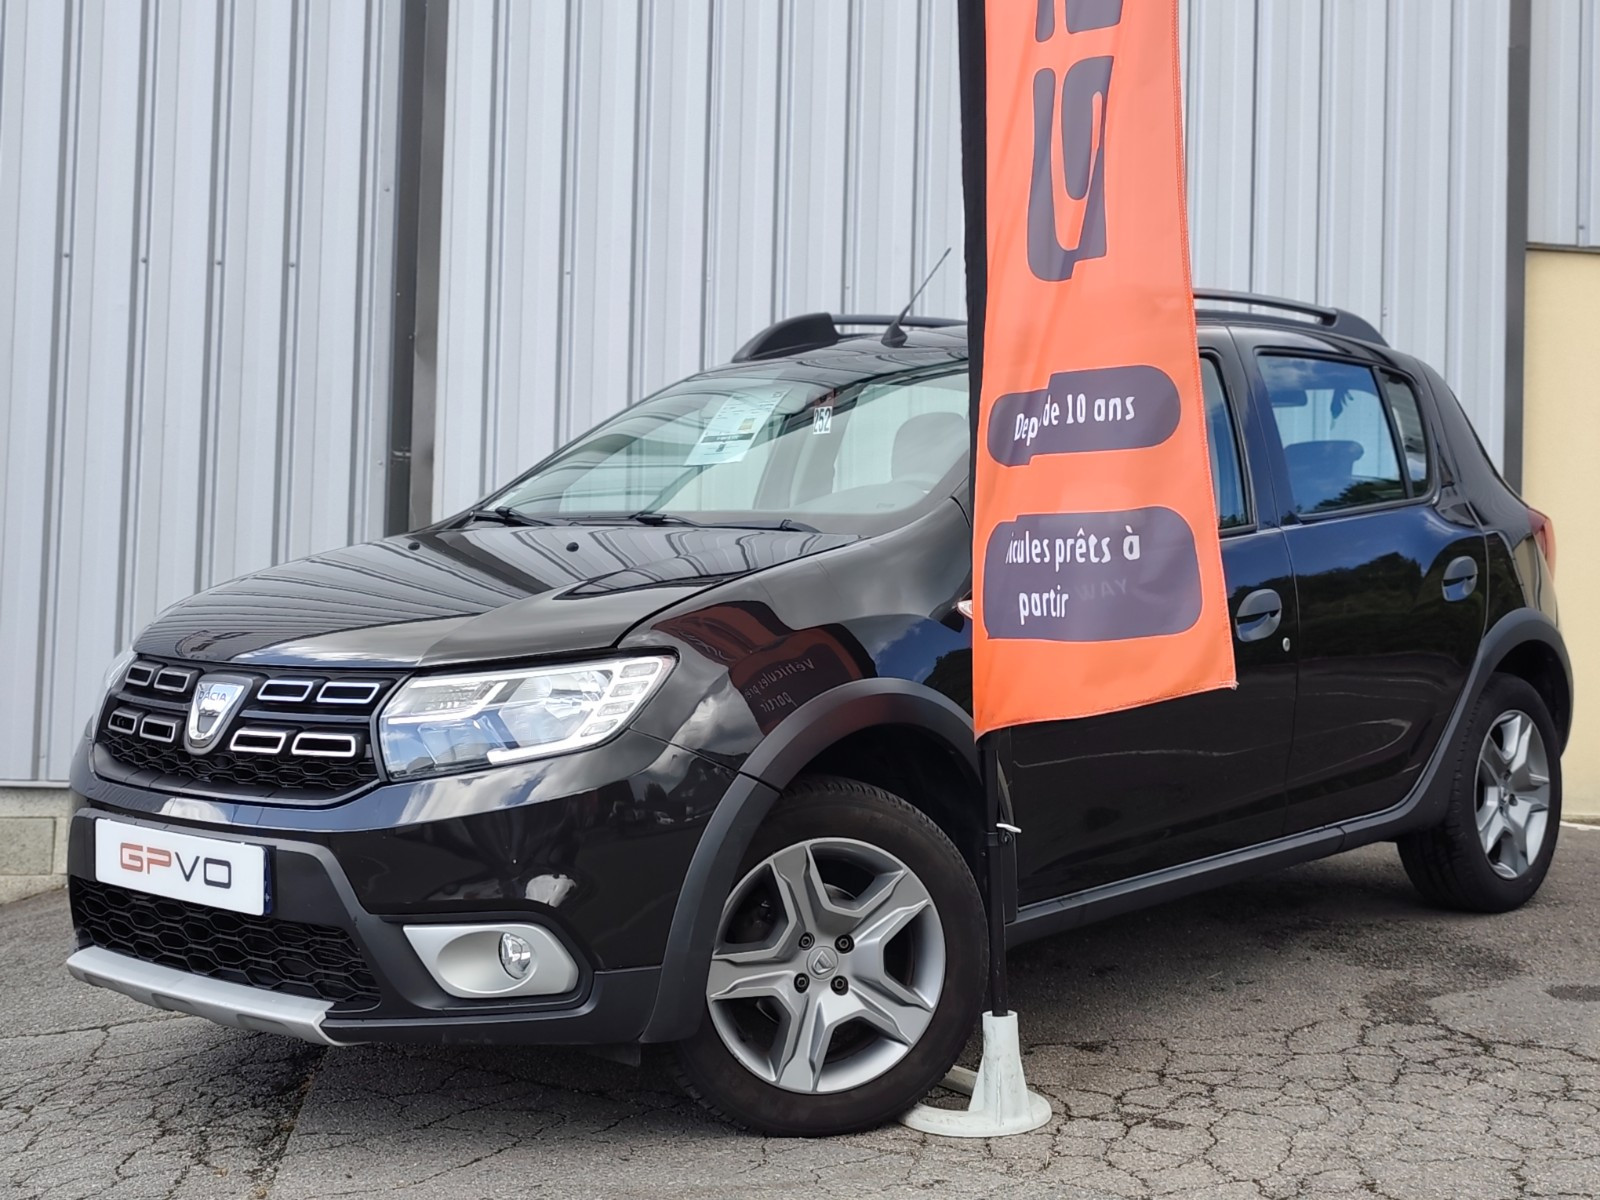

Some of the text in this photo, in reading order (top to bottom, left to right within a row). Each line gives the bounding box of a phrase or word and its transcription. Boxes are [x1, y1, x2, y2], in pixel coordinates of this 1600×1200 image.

[813, 407, 832, 433] 252
[1014, 393, 1136, 446] Dep de 10 ans
[1005, 525, 1141, 573] icules prêts à
[1018, 585, 1070, 626] partir
[198, 690, 227, 702] DACIA
[120, 842, 232, 890] GPVO
